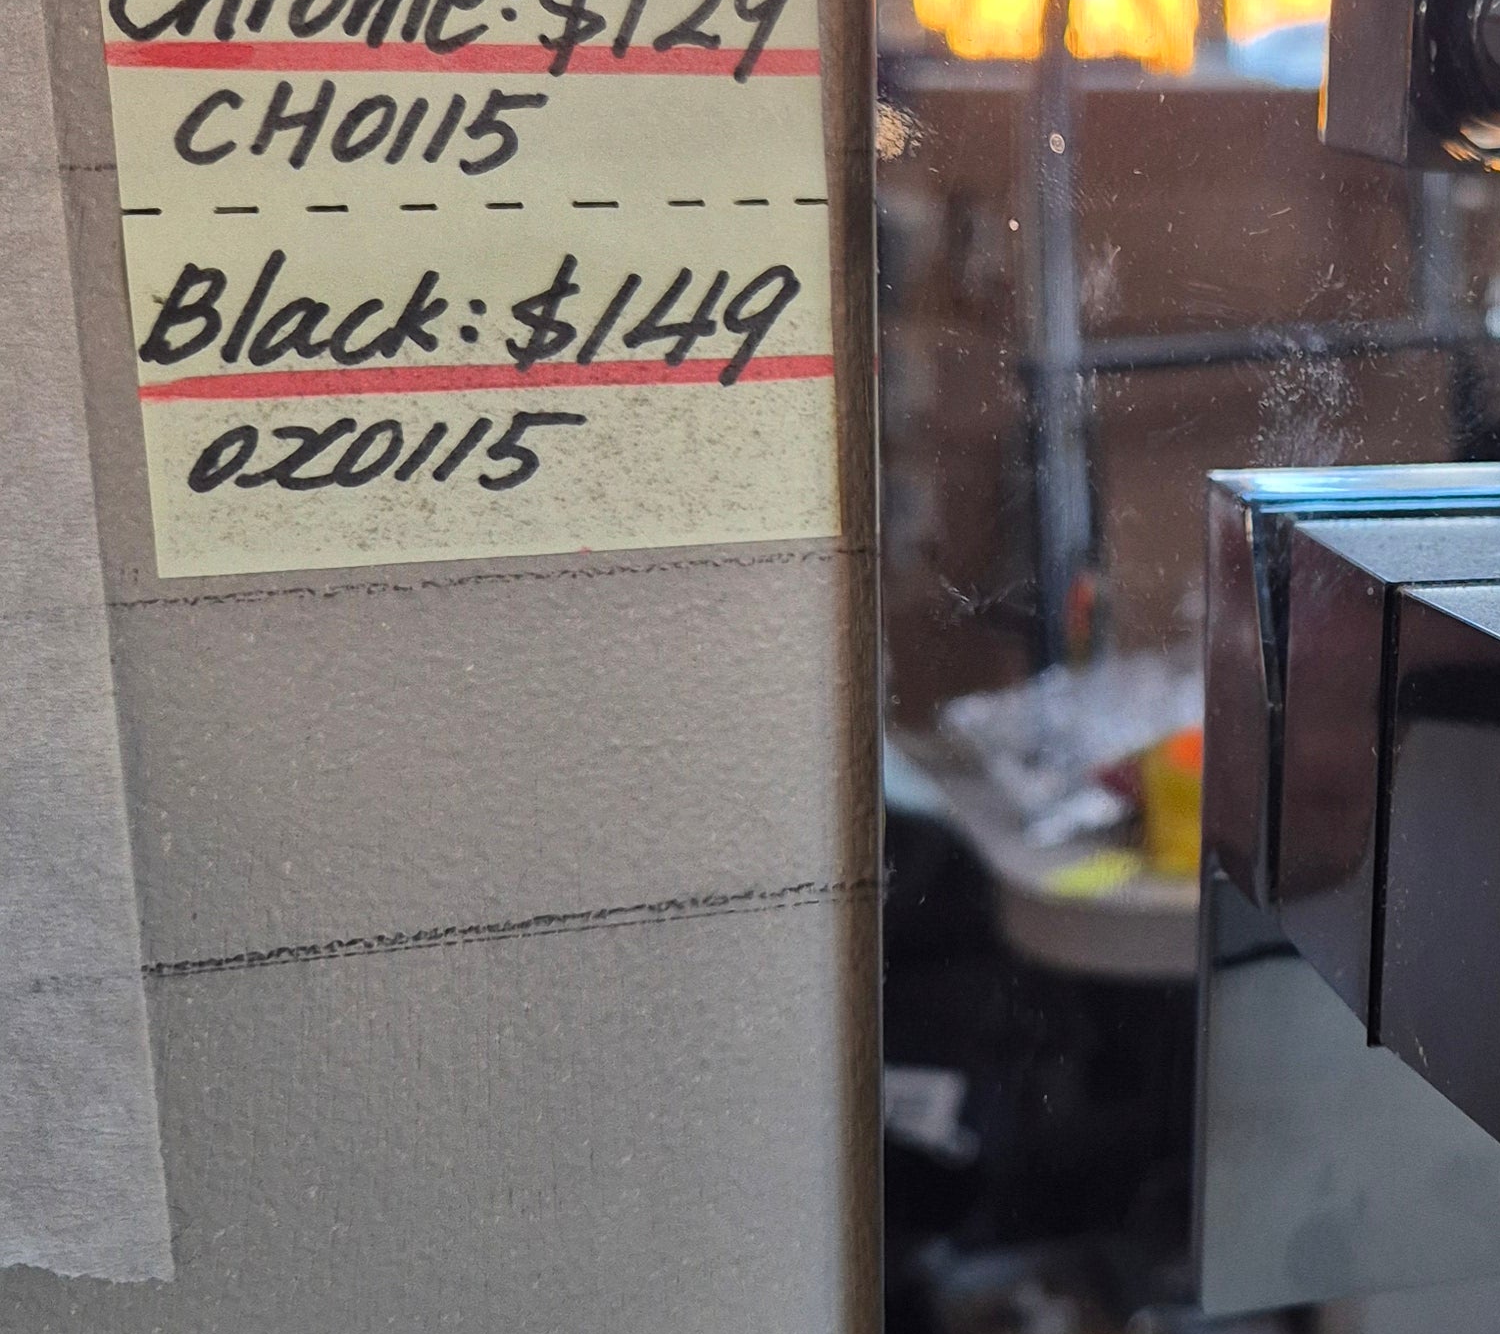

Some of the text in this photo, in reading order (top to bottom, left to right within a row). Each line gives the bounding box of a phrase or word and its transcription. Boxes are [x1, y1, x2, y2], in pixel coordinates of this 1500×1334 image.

[172, 79, 550, 177] CH0115
[137, 247, 803, 386] Black: $149
